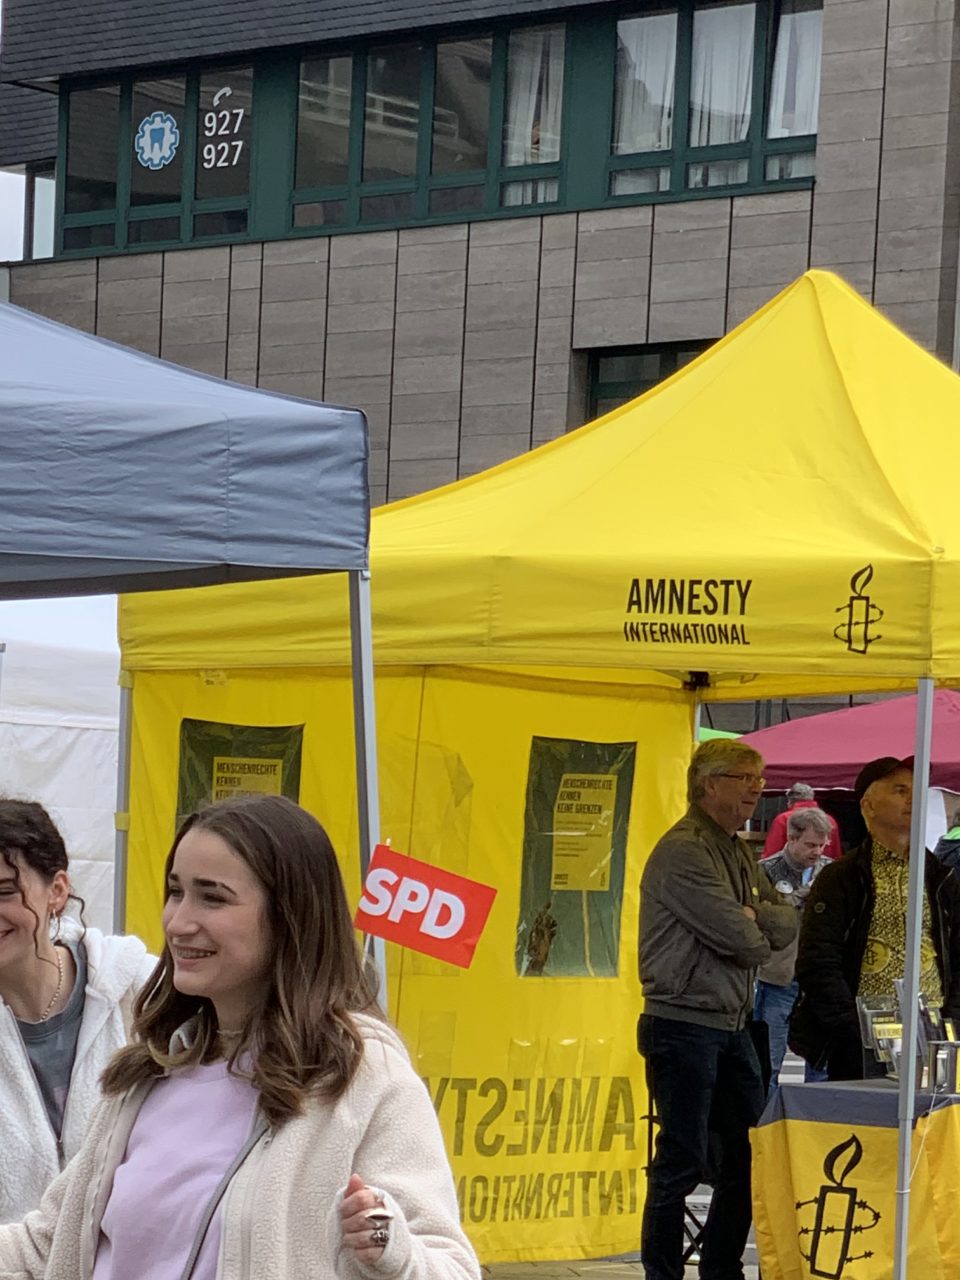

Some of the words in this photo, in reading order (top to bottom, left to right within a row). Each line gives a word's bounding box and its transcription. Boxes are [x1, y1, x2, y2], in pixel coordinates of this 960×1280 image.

[204, 109, 244, 137] 927
[203, 141, 244, 169] 927
[626, 578, 752, 616] AMNESTY
[624, 621, 750, 646] INTERNATIONAL
[359, 868, 466, 939] SPD
